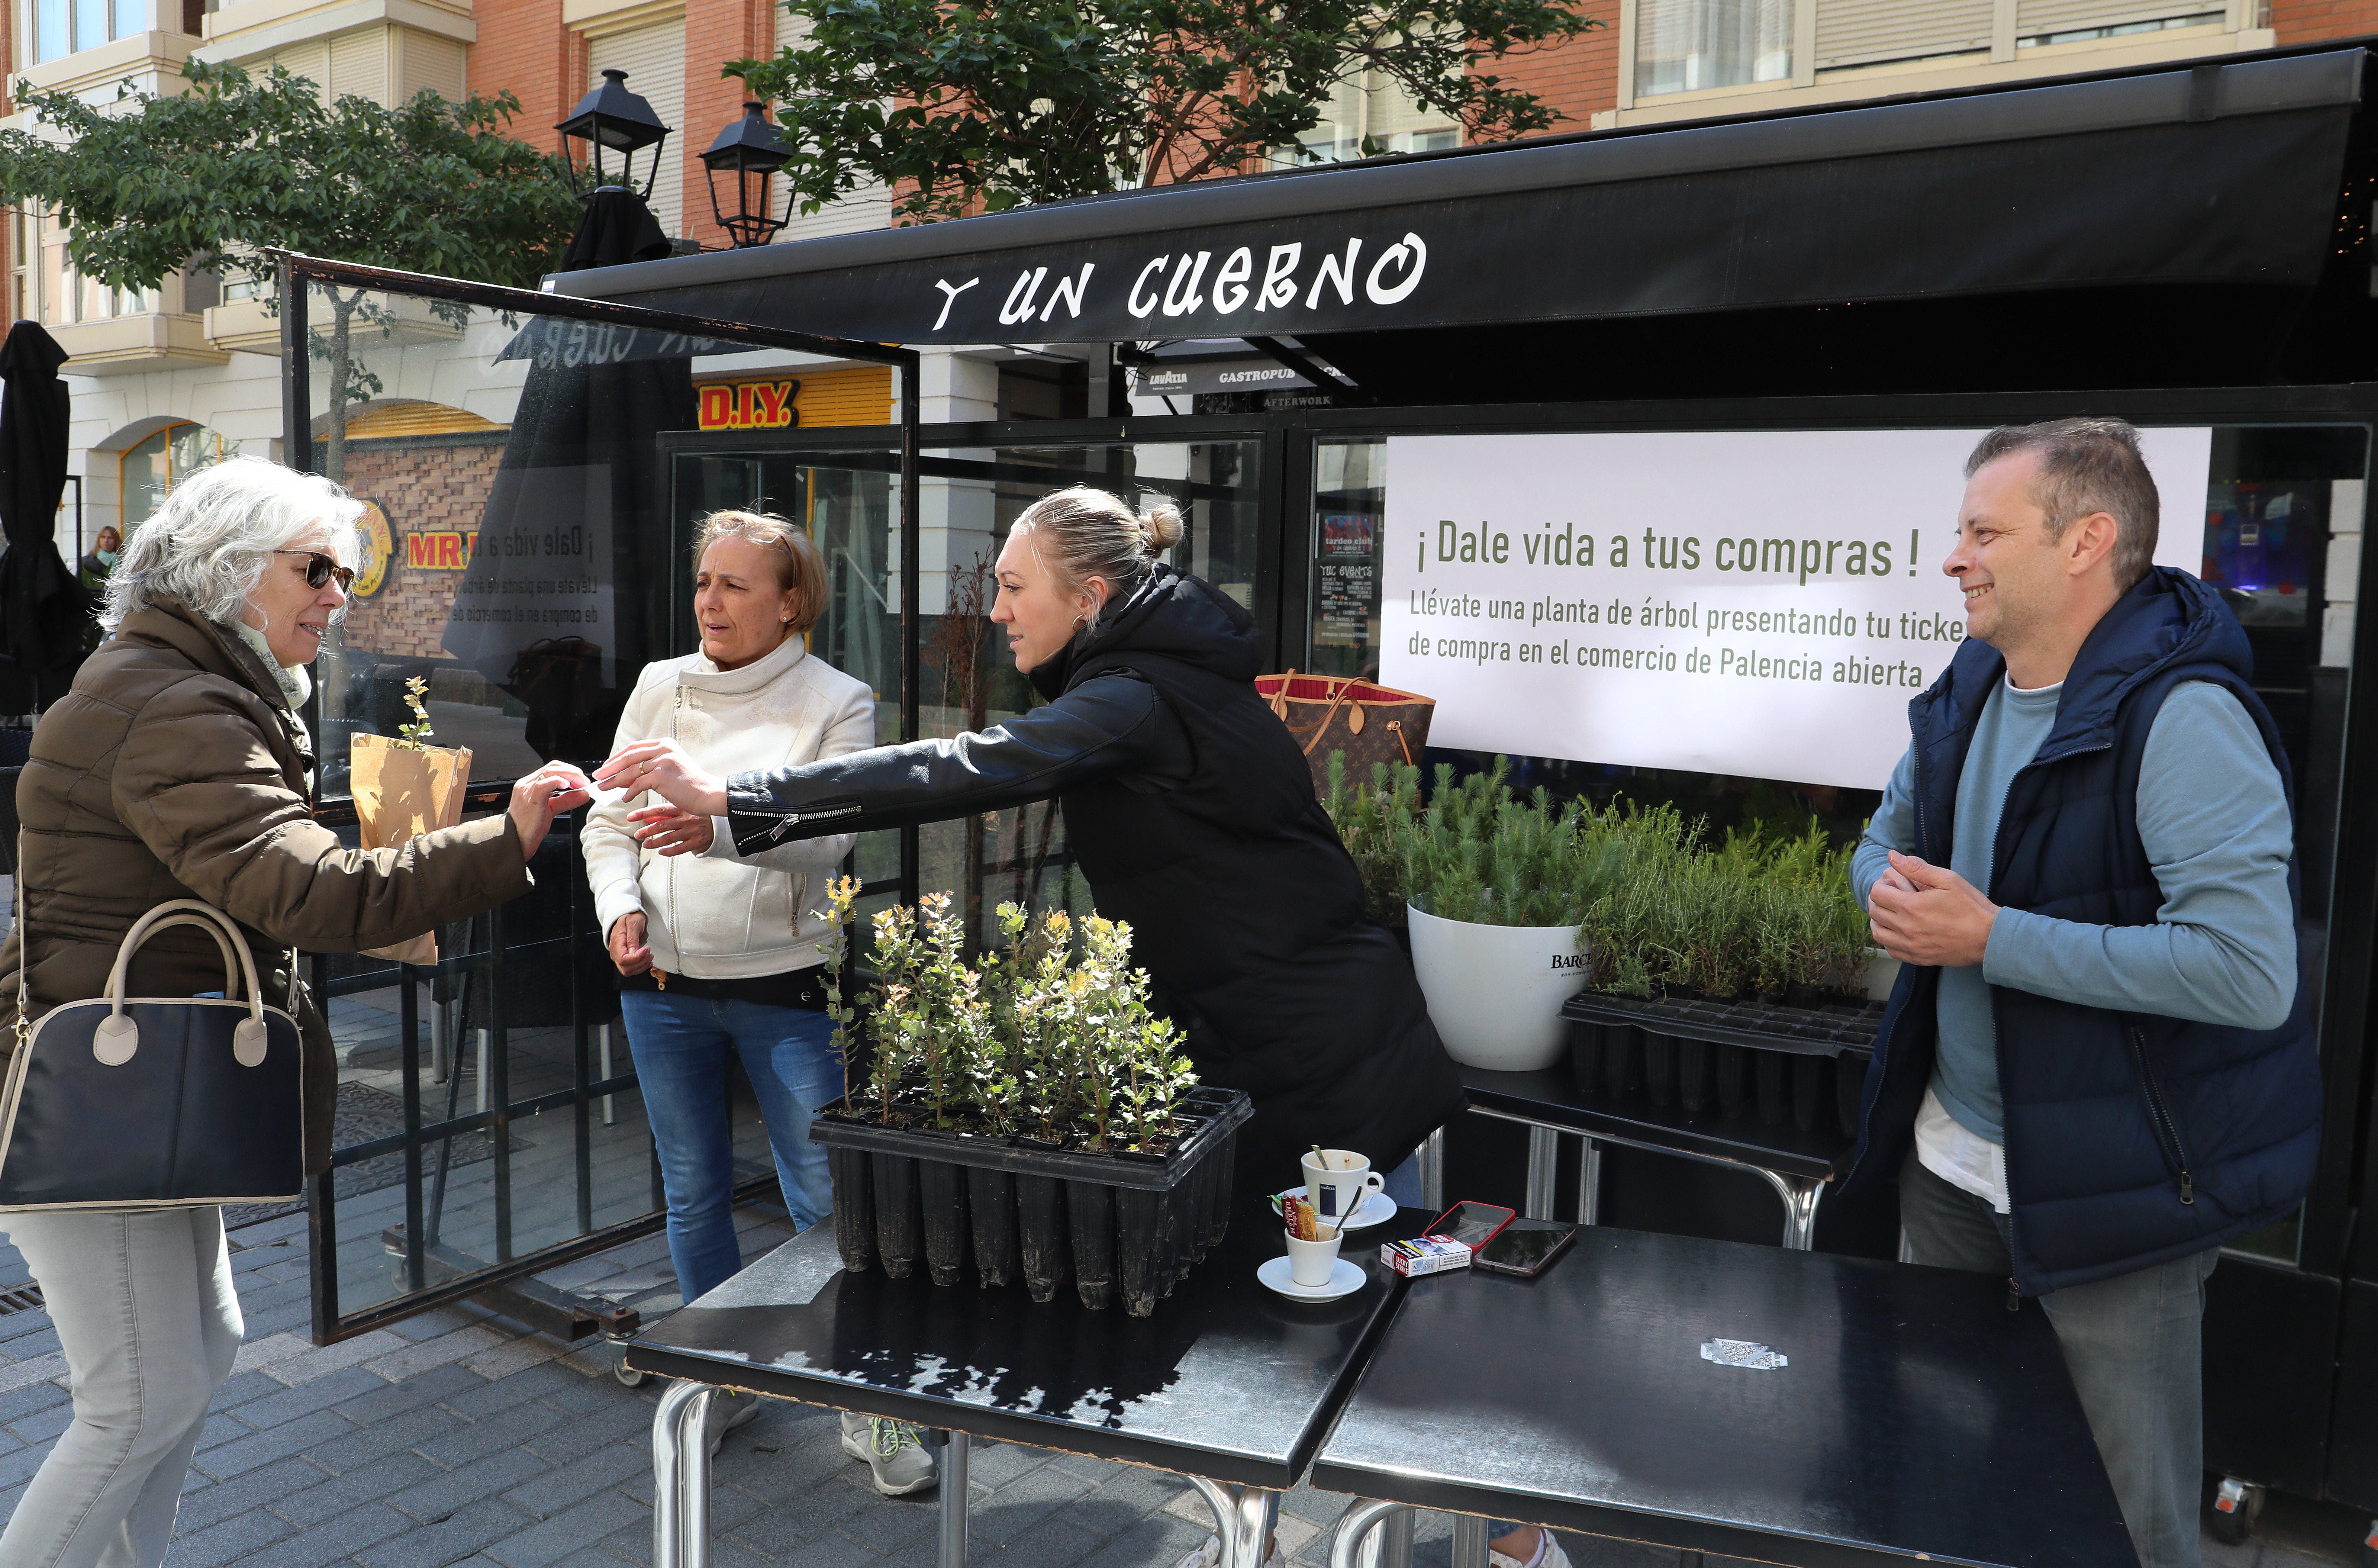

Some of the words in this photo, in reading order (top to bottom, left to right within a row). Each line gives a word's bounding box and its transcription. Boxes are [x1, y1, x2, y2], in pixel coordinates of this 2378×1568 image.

[932, 277, 979, 331] Y
[999, 262, 1095, 325] UN
[1128, 232, 1427, 319] CUERNO
[1149, 371, 1188, 385] LAVAZZA
[1219, 368, 1296, 383] GASTROPUB
[702, 385, 789, 426] D.I.Y.
[1264, 396, 1331, 407] AFTERWORK
[1438, 520, 1509, 564] Dale
[1523, 522, 1594, 567] vida
[1610, 535, 1628, 568] a
[1643, 527, 1700, 570] tus
[1715, 537, 1892, 586] compras
[1411, 587, 1481, 618] Llévate
[1489, 600, 1524, 620] una
[1532, 595, 1599, 628] planta
[1607, 598, 1632, 626] de
[1640, 596, 1698, 629] árbol
[1707, 608, 1857, 637] presentando
[1866, 611, 1891, 639] tu
[1900, 611, 1963, 642] ticke
[1409, 631, 1430, 656] de
[1437, 638, 1511, 666] compra
[1519, 643, 1543, 663] en
[1551, 638, 1569, 665] el
[1577, 644, 1677, 672] comercio
[1686, 646, 1711, 674] de
[1720, 647, 1822, 682] Palencia
[1833, 655, 1922, 688] abierta
[1551, 953, 1592, 969] BARCE
[1395, 1262, 1408, 1275] STRIKE
[1396, 1255, 1408, 1268] LUCKY
